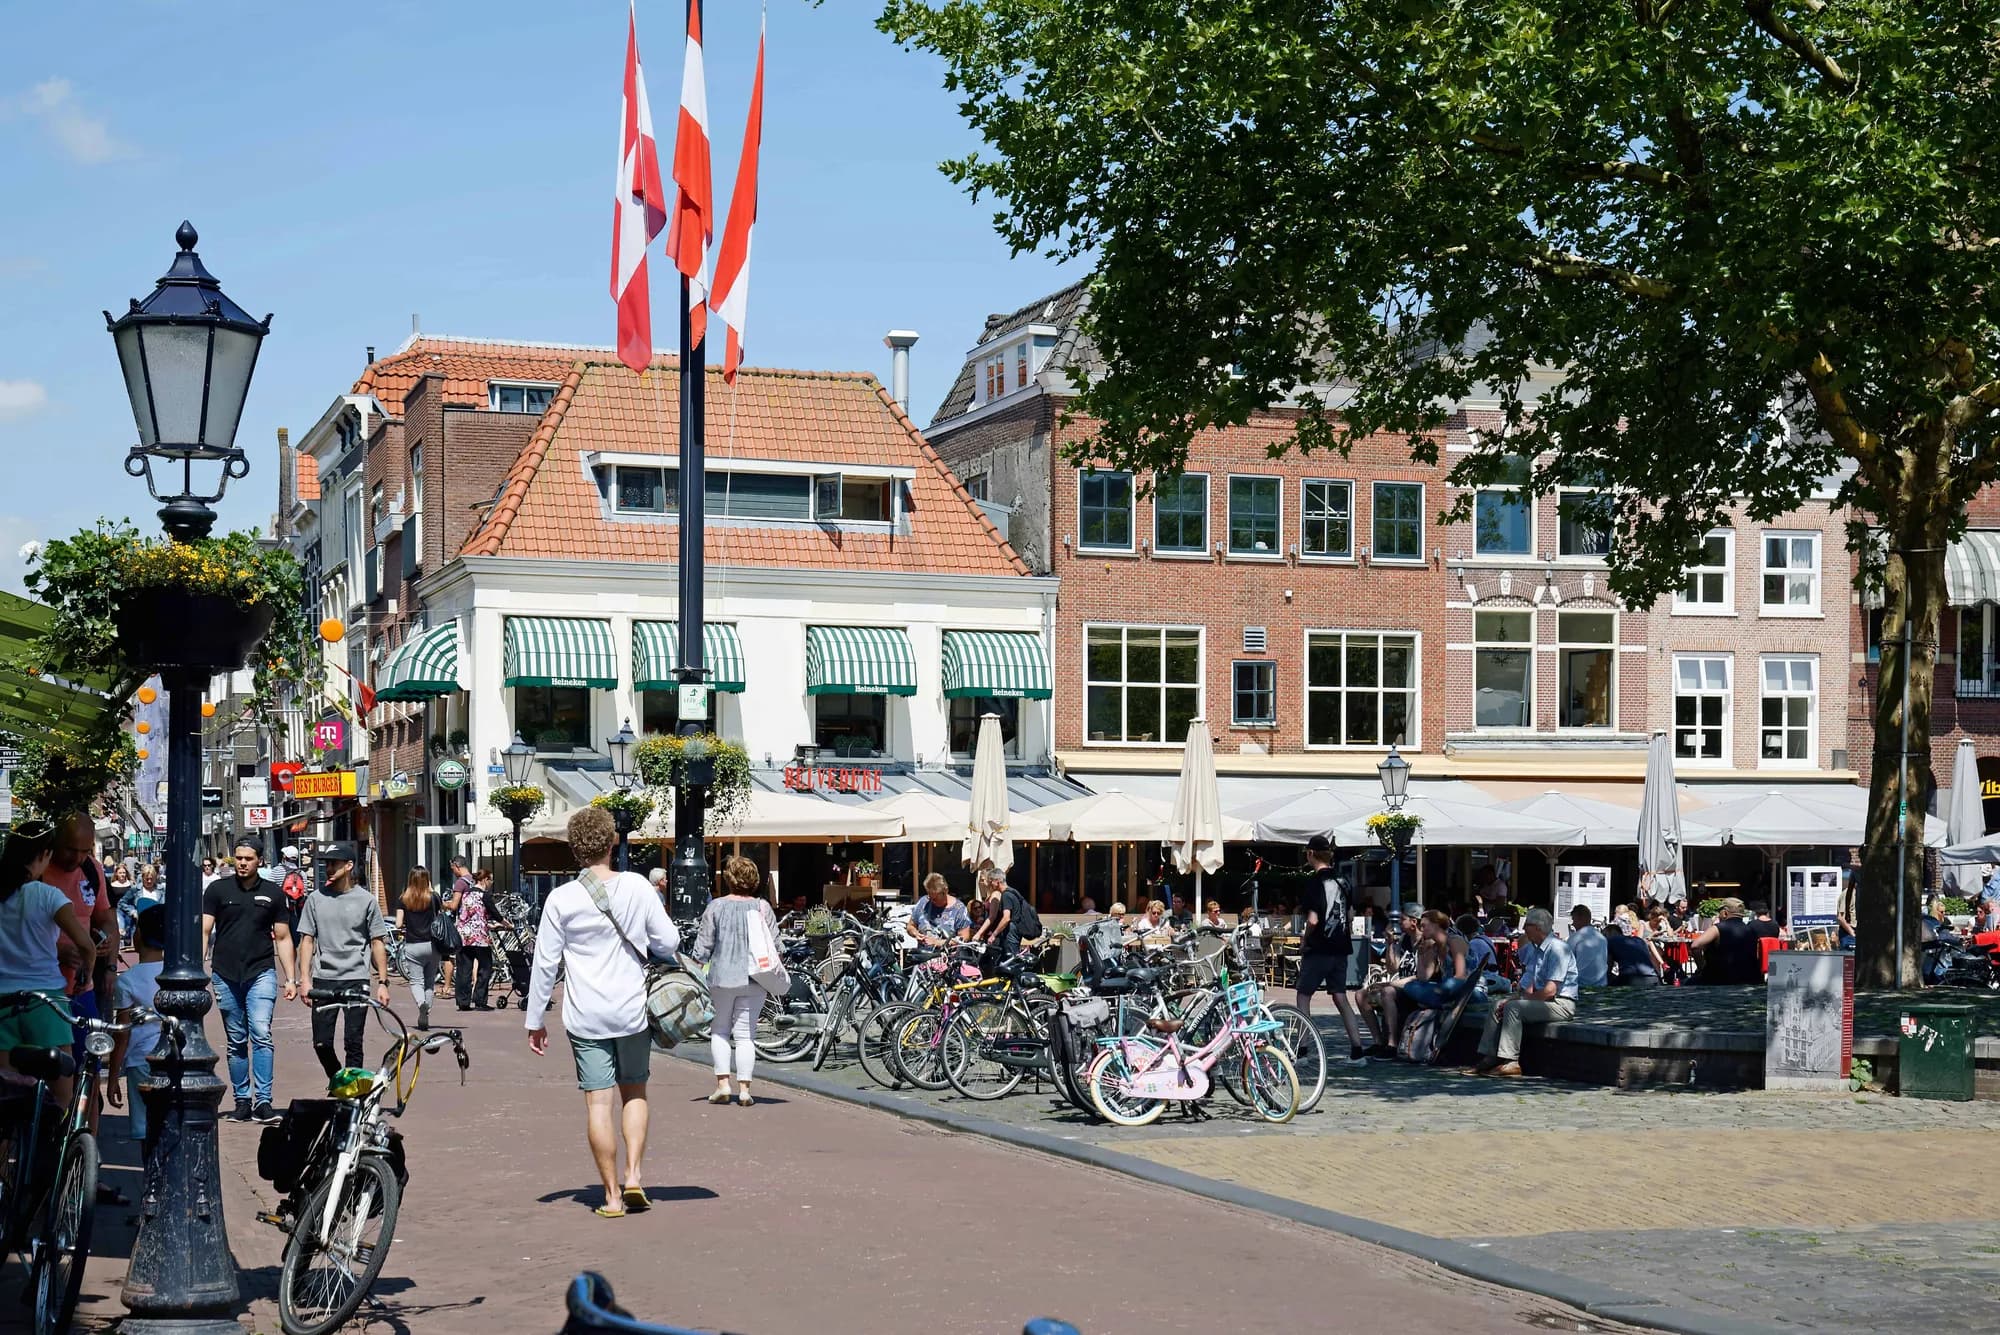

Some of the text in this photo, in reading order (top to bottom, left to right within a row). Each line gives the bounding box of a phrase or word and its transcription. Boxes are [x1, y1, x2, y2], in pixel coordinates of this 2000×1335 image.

[551, 677, 587, 686] Heineken
[855, 684, 889, 692] Heineken
[992, 689, 1025, 697] Heineken
[785, 767, 882, 791] BELVEDERE
[296, 776, 339, 795] BEST BURGER
